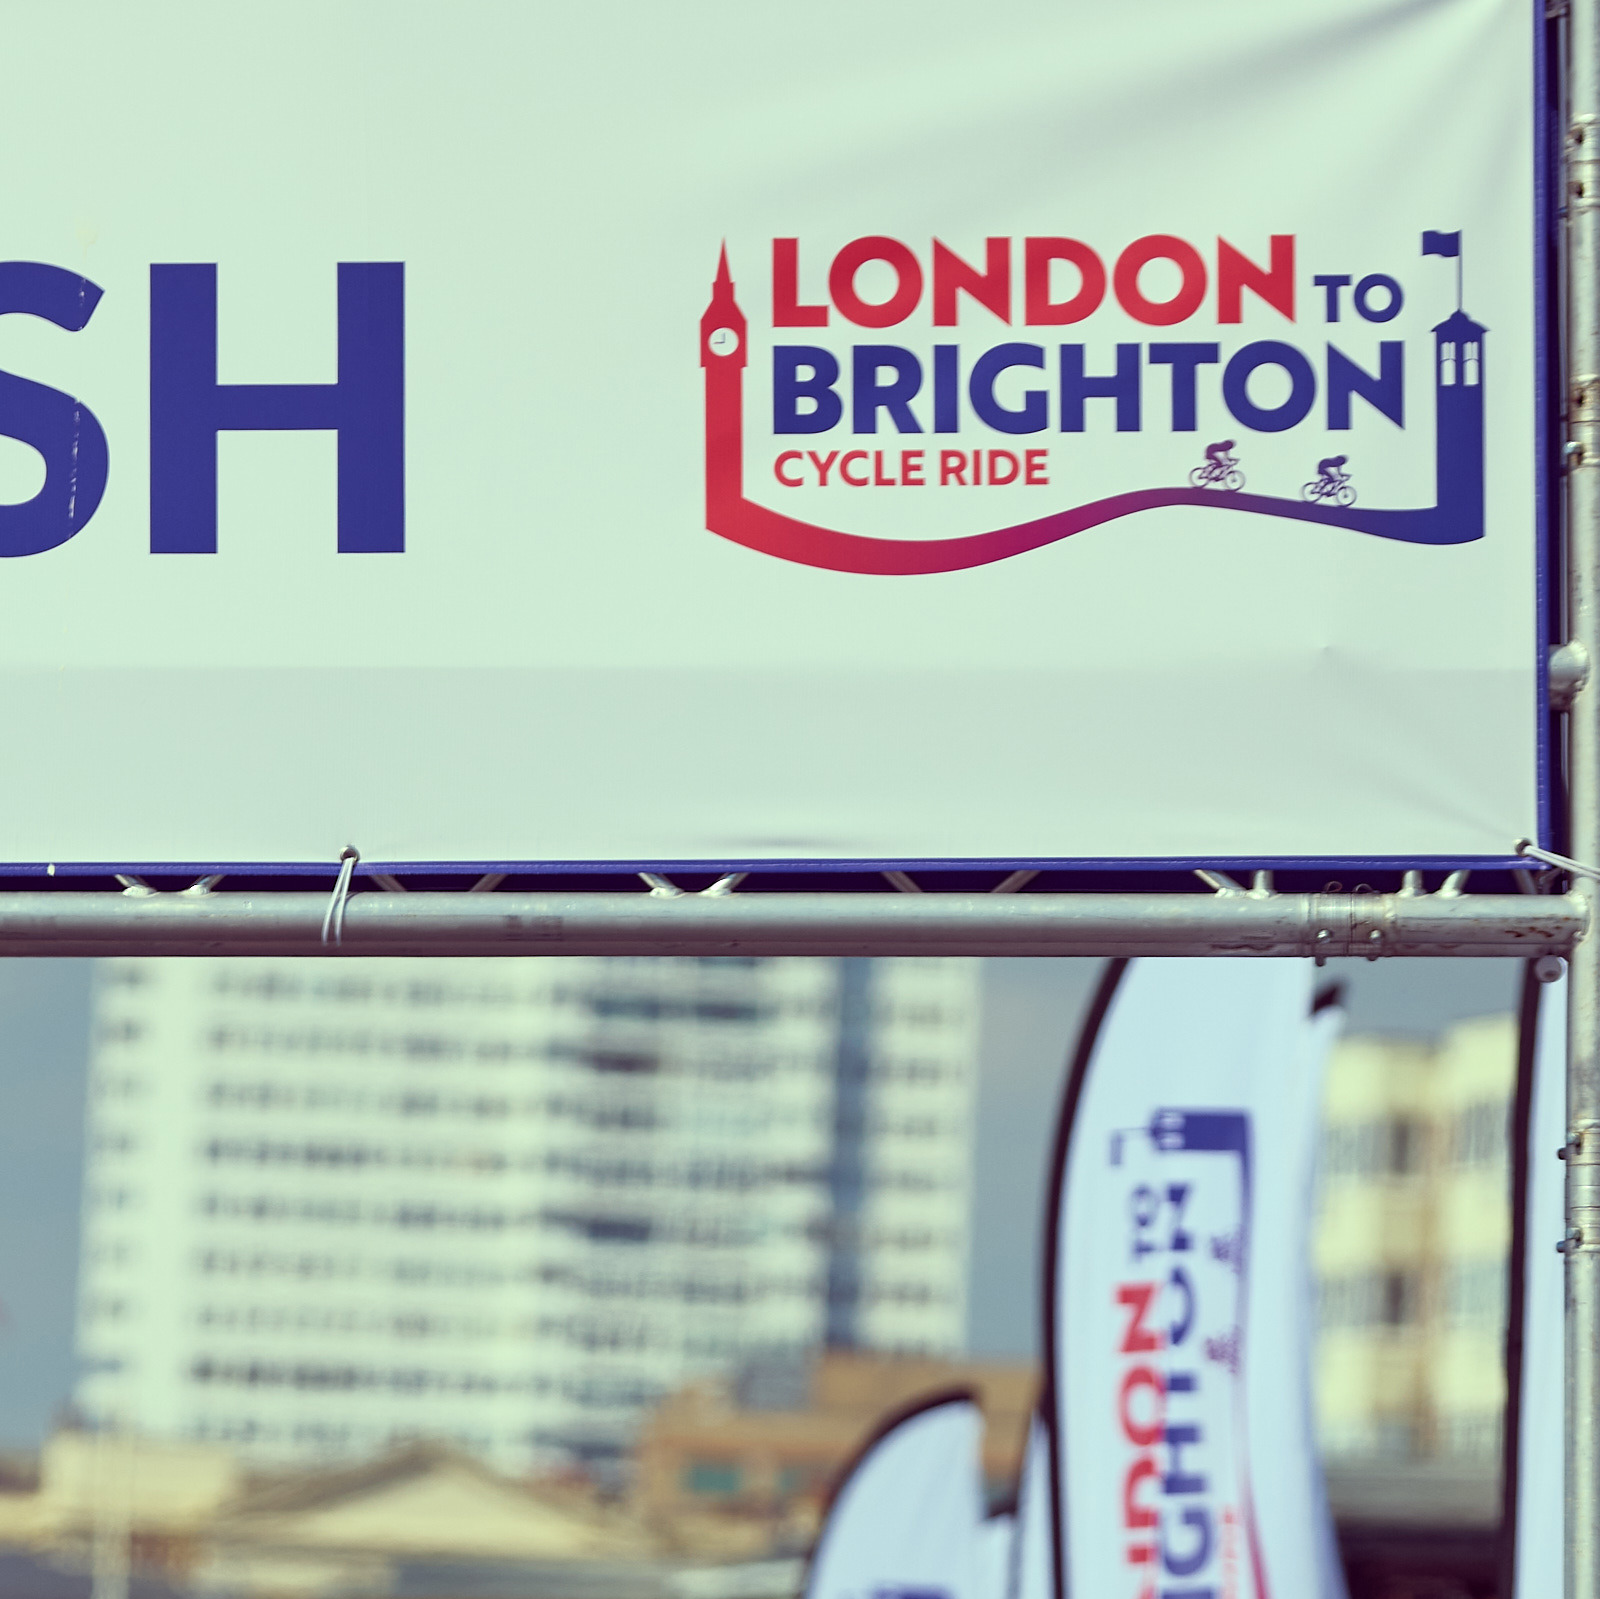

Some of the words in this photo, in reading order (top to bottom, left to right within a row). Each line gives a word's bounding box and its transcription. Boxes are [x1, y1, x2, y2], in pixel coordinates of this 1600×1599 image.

[771, 233, 1297, 329] LONDON
[1314, 272, 1404, 325] TO
[771, 339, 1406, 436] BRIGHTON
[772, 449, 926, 489] CYCLE
[937, 448, 1051, 488] RIDE
